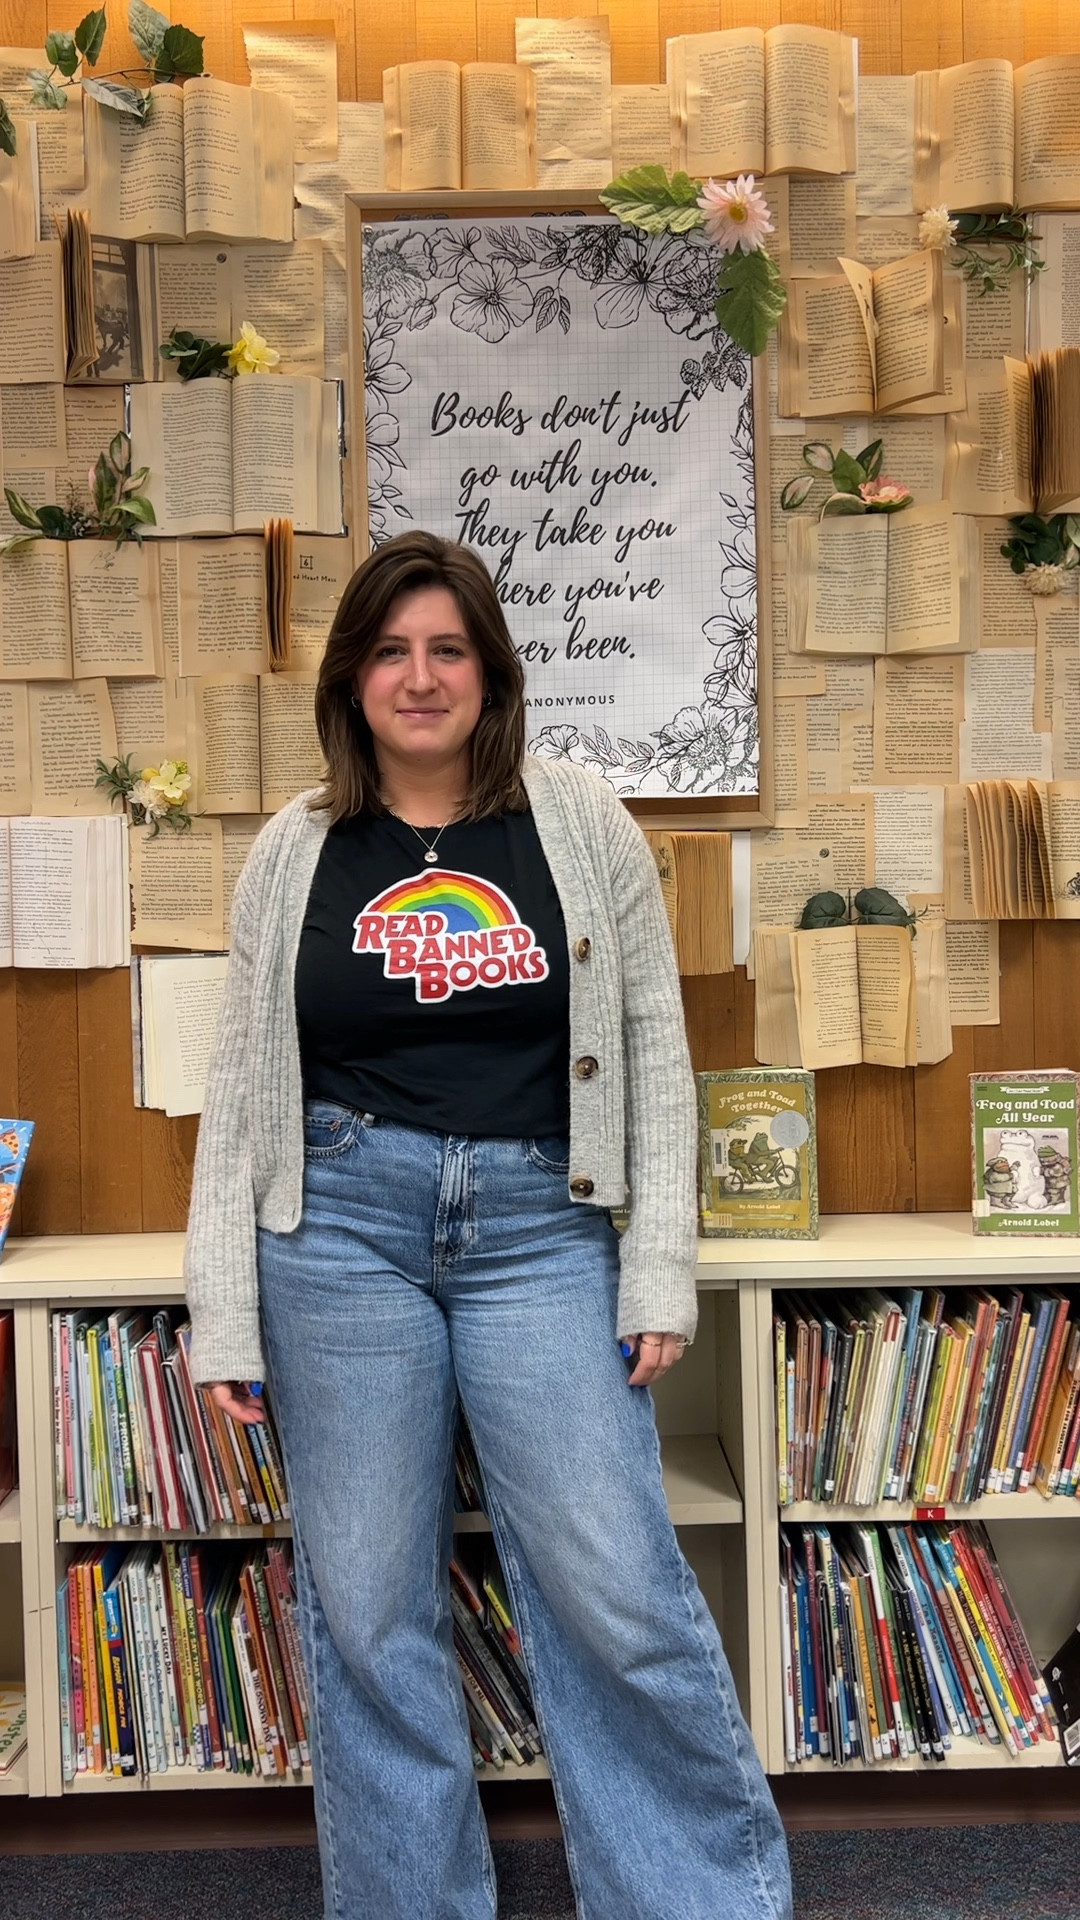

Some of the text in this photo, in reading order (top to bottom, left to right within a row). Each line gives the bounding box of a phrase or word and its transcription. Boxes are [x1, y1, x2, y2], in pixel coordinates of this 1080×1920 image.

[431, 390, 691, 447] Books don't just
[459, 439, 658, 508] go with you.
[455, 498, 677, 565] They take you
[494, 556, 665, 623] here you've
[565, 616, 636, 660] been.
[524, 694, 616, 708] ANONYMOUS
[357, 914, 444, 949] READ
[387, 927, 531, 974] BANNED
[415, 951, 545, 999] BOOKS
[718, 1089, 796, 1109] Frog and Toad
[730, 1100, 783, 1114] Together
[976, 1099, 1075, 1112] Frog and Toad
[996, 1112, 1056, 1124] All Year
[998, 1218, 1060, 1227] Arnold Lobel
[119, 1420, 131, 1468] PROMISE
[928, 1510, 934, 1518] K
[826, 1560, 839, 1629] LUNCH HOME
[186, 1608, 195, 1634] DON'T
[160, 1626, 172, 1676] MY LUCKY DAY
[189, 1637, 198, 1652] SAY
[955, 1639, 970, 1662] GIFT
[192, 1656, 200, 1675] THAT
[466, 1674, 478, 1690] FOR
[475, 1689, 486, 1703] ME!
[251, 1675, 273, 1744] THE SNOWY DAY
